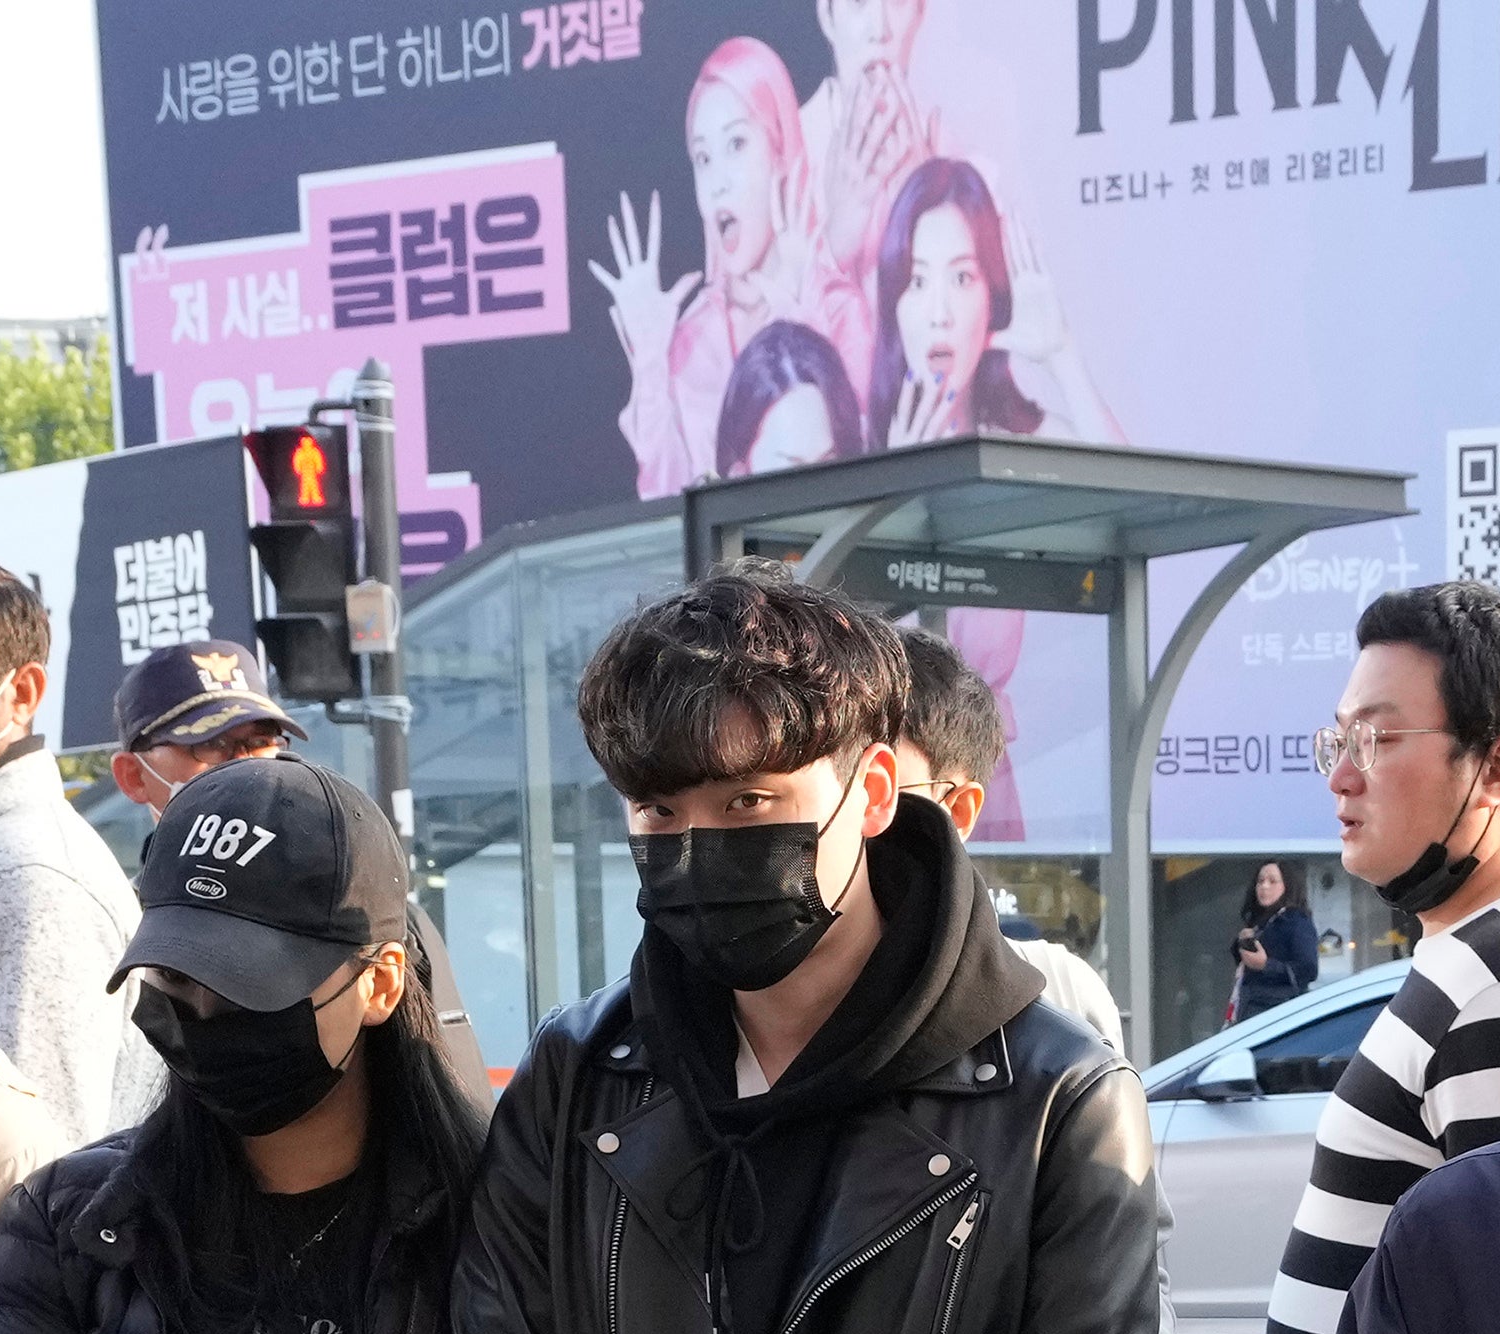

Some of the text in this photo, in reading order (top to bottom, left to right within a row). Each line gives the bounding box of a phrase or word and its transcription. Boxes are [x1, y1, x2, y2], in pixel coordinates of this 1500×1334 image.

[156, 0, 644, 124] 사랑을 위한 단 하나의 거짓말
[1080, 143, 1387, 206] 디즈니+ 첫 연애 리얼리티
[328, 194, 545, 331] 클럽은
[169, 275, 209, 345] 저
[113, 530, 207, 604] 더불어
[886, 560, 942, 594] 이태원
[117, 592, 214, 666] 민주당
[1290, 629, 1356, 664] 스트리
[1155, 734, 1272, 776] 핑크문이
[179, 813, 277, 868] 1987
